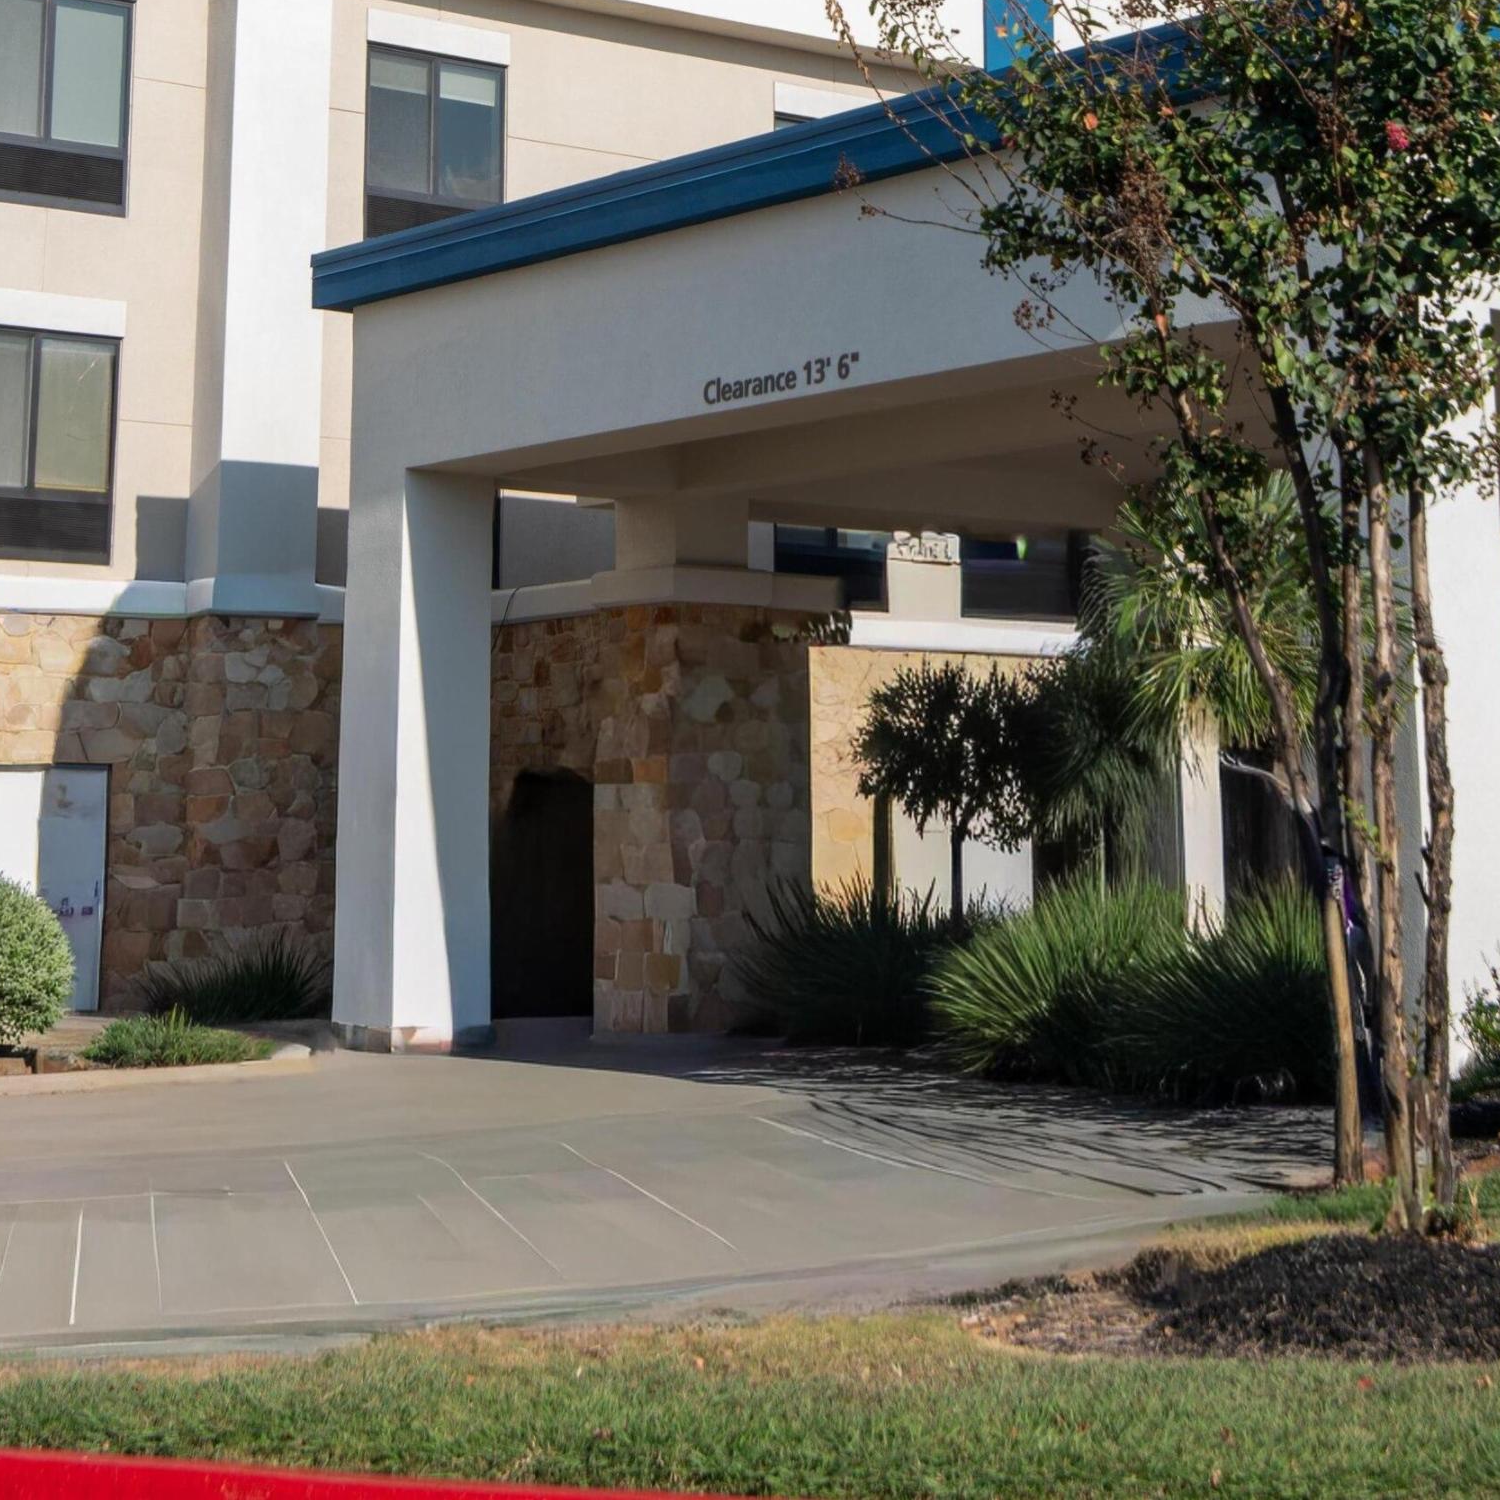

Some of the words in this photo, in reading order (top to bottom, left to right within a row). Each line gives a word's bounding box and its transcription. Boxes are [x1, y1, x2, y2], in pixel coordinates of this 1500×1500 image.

[703, 369, 797, 405] Clearance
[803, 356, 831, 385] 13'
[837, 351, 860, 380] 6"
